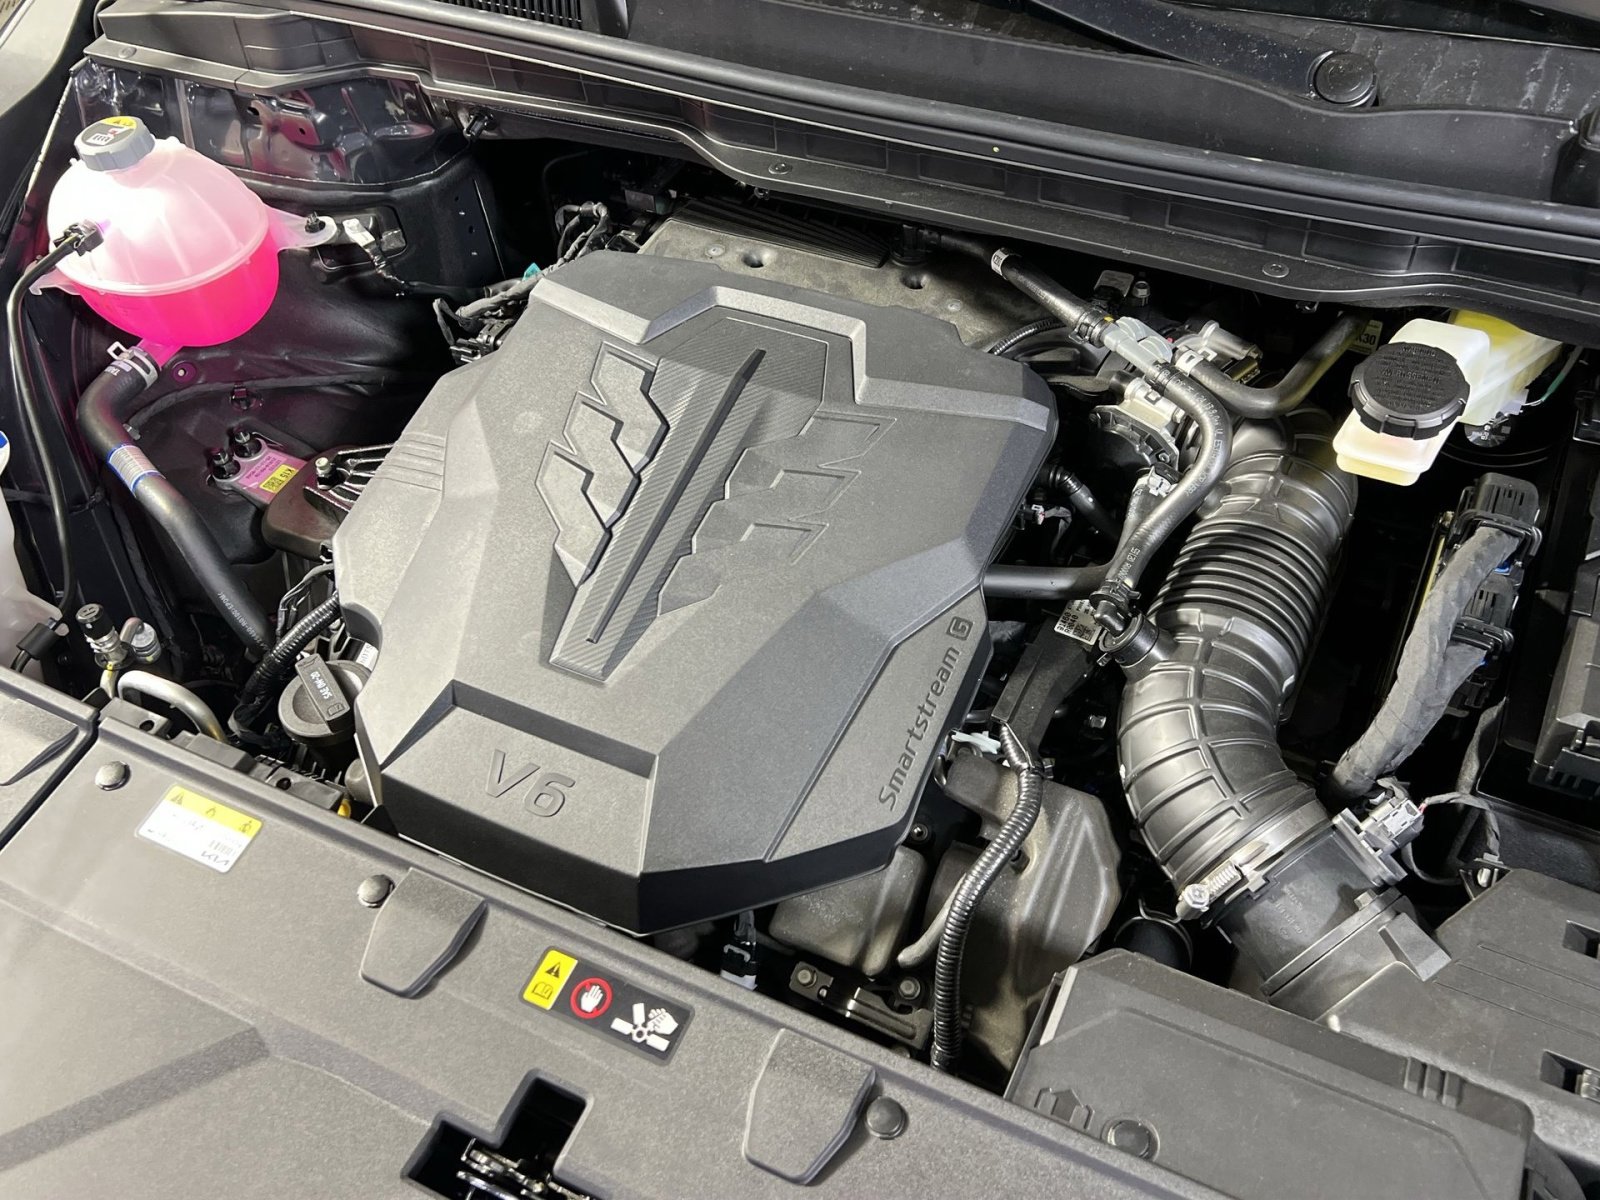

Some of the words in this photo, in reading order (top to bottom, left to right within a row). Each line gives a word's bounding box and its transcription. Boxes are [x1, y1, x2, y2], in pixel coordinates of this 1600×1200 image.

[319, 685, 332, 699] SAE
[878, 647, 960, 811] Smartstream
[485, 749, 576, 817] V6
